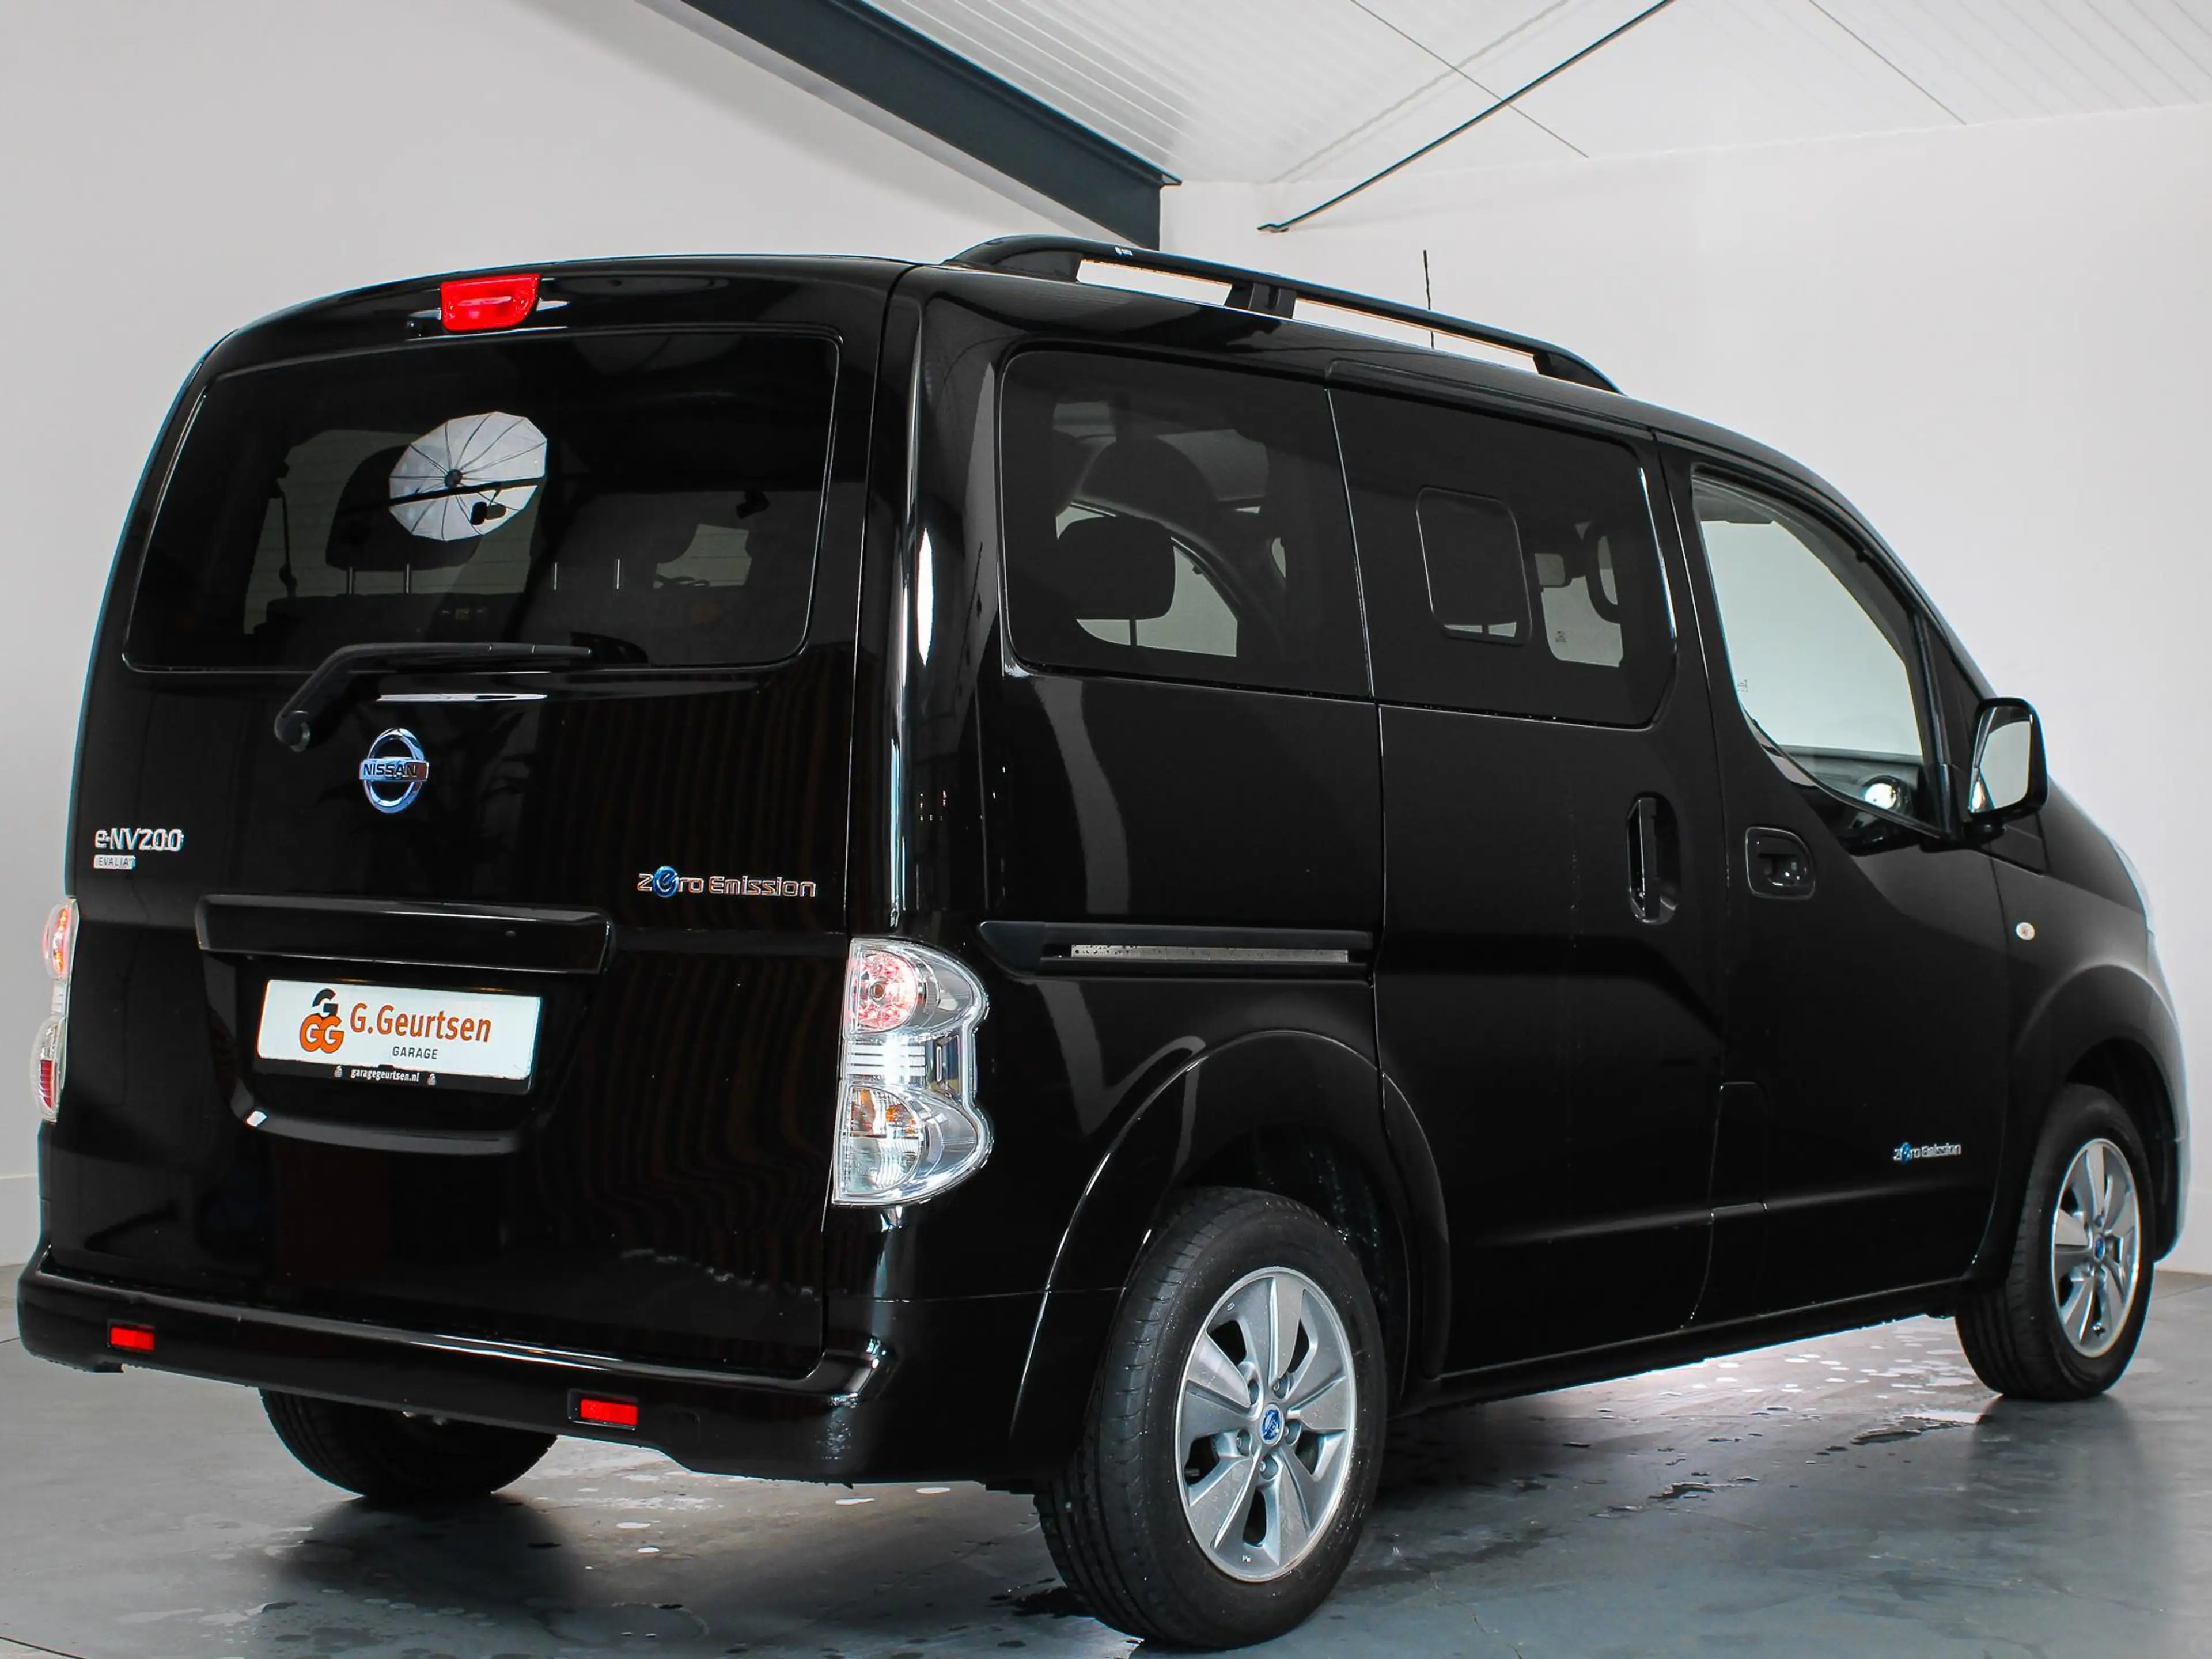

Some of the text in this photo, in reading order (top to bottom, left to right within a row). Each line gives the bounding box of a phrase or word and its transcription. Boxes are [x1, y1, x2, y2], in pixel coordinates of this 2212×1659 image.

[363, 763, 418, 777] NISSAN
[98, 857, 129, 866] EVALIA
[709, 875, 817, 897] Emission
[350, 1002, 492, 1043] G.Geurtsen
[392, 1046, 438, 1060] GARAGE
[350, 1068, 421, 1083] garagegeurtsen.nl
